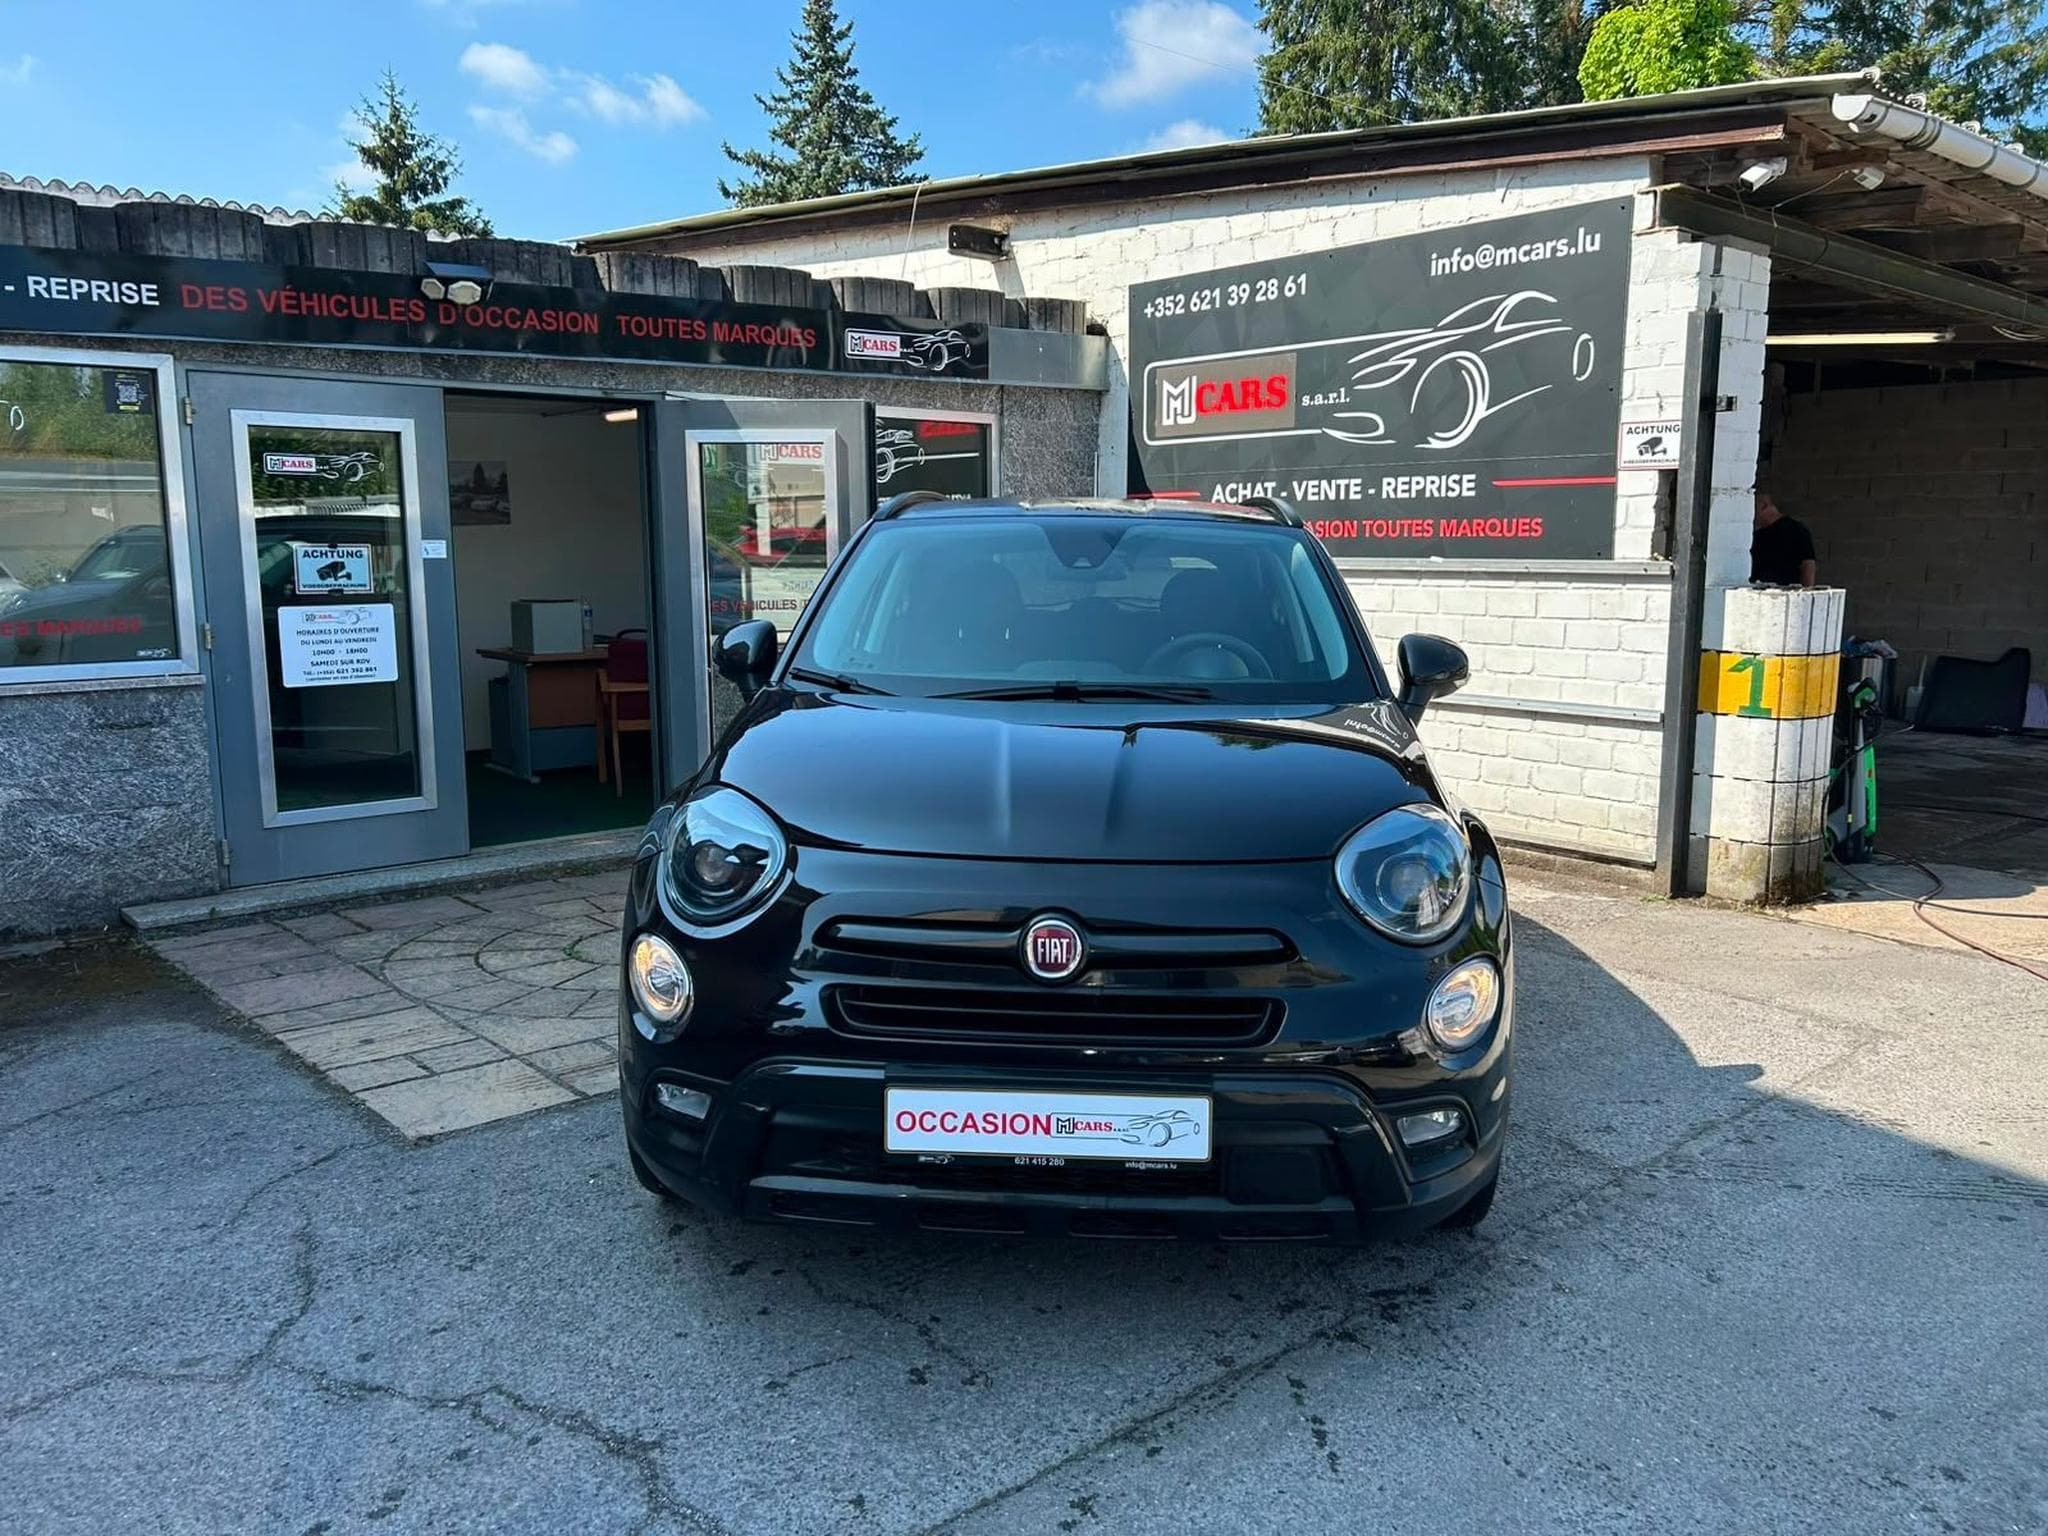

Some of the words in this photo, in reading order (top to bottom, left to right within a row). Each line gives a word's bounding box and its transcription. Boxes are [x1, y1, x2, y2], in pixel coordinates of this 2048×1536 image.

[1429, 227, 1602, 276] info@mcars.lu
[1143, 293, 1186, 318] +352
[1190, 288, 1222, 313] 621
[1227, 282, 1250, 306] 39
[1255, 278, 1279, 302] 28
[1284, 273, 1308, 297] 61
[27, 275, 160, 306] REPRISE
[180, 284, 248, 312] DES
[257, 284, 426, 321] VÉHICULES
[438, 303, 599, 334] D'OCCASION
[616, 314, 707, 341] TOUTES
[712, 321, 817, 349] MARQUES
[1301, 387, 1351, 406] s.a.r.l.
[1626, 424, 1681, 435] ACHTUNG
[1210, 481, 1277, 504] ACHAT
[1292, 478, 1362, 501] VENTE
[1381, 474, 1477, 500] REPRISE
[1362, 519, 1435, 538] TOUTES
[1439, 517, 1544, 538] MARQUES
[302, 549, 364, 559] ACHTUNG
[296, 628, 332, 636] HORAIRES
[310, 659, 339, 667] SAMEDI
[1727, 655, 1772, 717] 1
[1037, 938, 1070, 964] FIAT
[895, 1110, 1051, 1136] OCCASION
[1014, 1157, 1030, 1165] 621
[1032, 1157, 1047, 1166] 415
[1049, 1158, 1065, 1166] 280
[1125, 1162, 1177, 1170] info@mcars.lu
